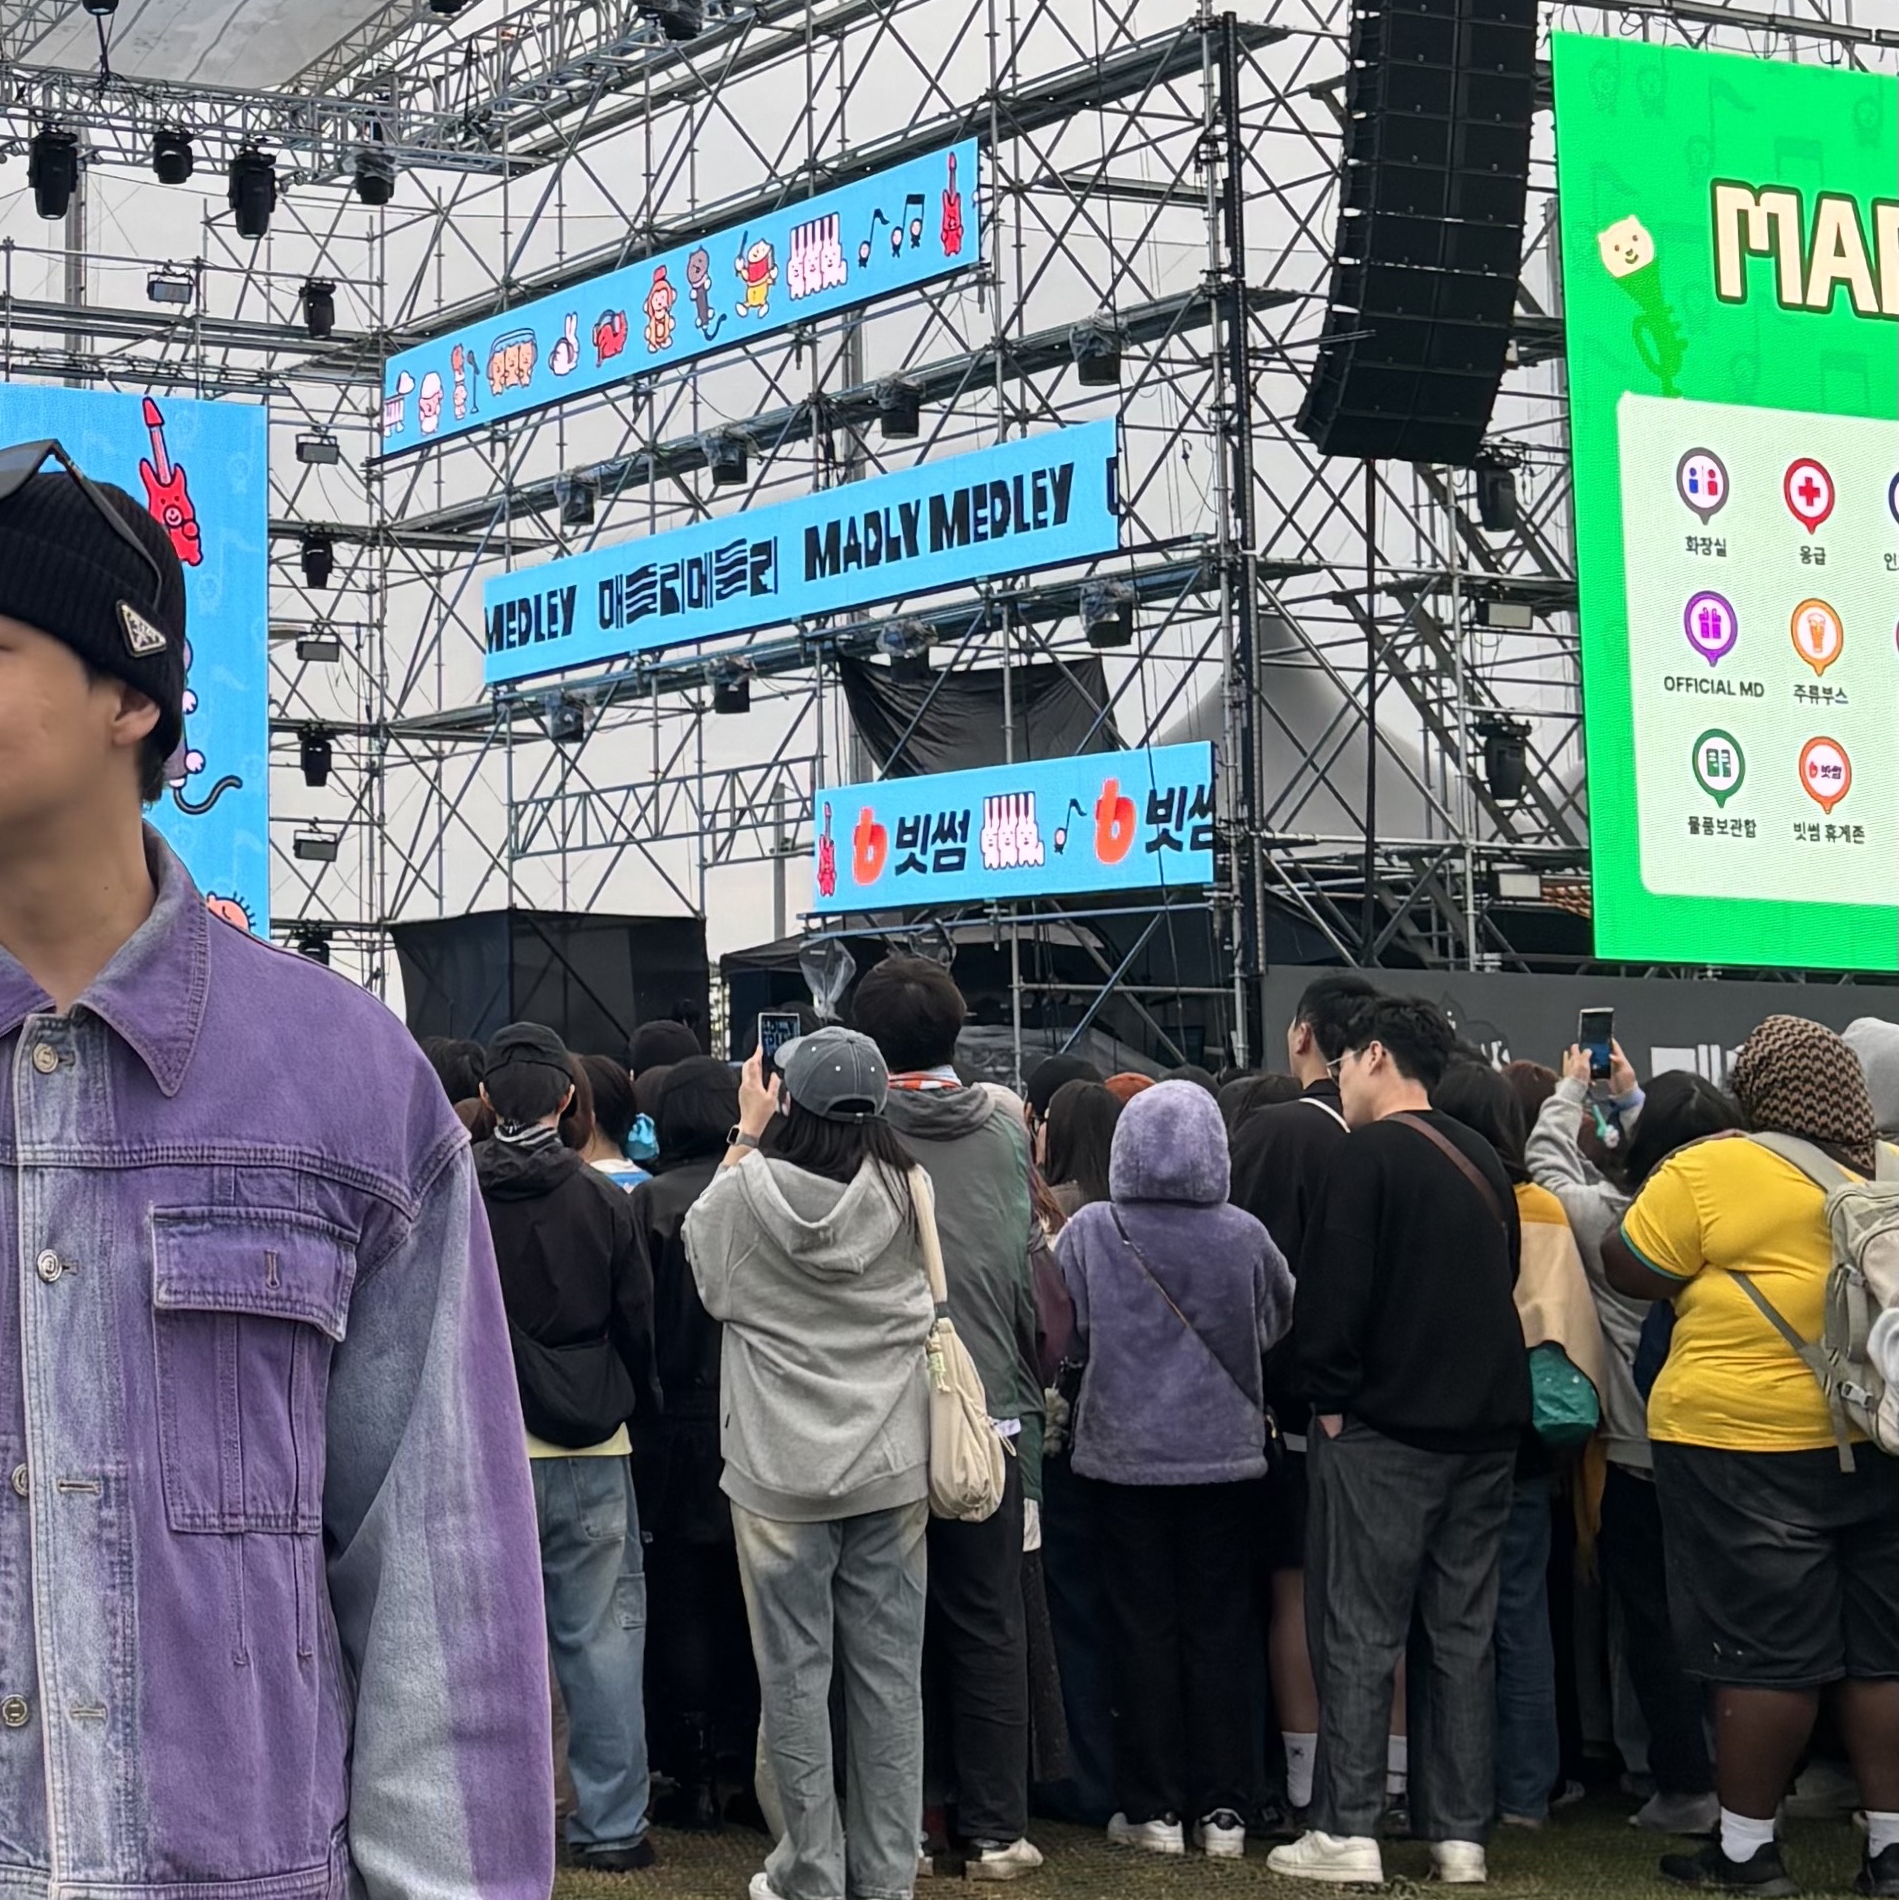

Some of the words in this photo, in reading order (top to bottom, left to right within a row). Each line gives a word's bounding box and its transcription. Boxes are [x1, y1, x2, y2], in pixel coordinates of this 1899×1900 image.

[1710, 177, 1899, 322] MA
[804, 499, 921, 582] MADLY
[929, 461, 1075, 553] MEDLEY
[1685, 535, 1727, 558] 화장실
[1799, 545, 1826, 566] 응급
[1664, 676, 1736, 696] OFFICIAL
[1739, 681, 1765, 698] MD
[1793, 684, 1849, 705] 주류부스
[895, 808, 971, 876] 빗썸
[1824, 823, 1865, 845] 휴게존
